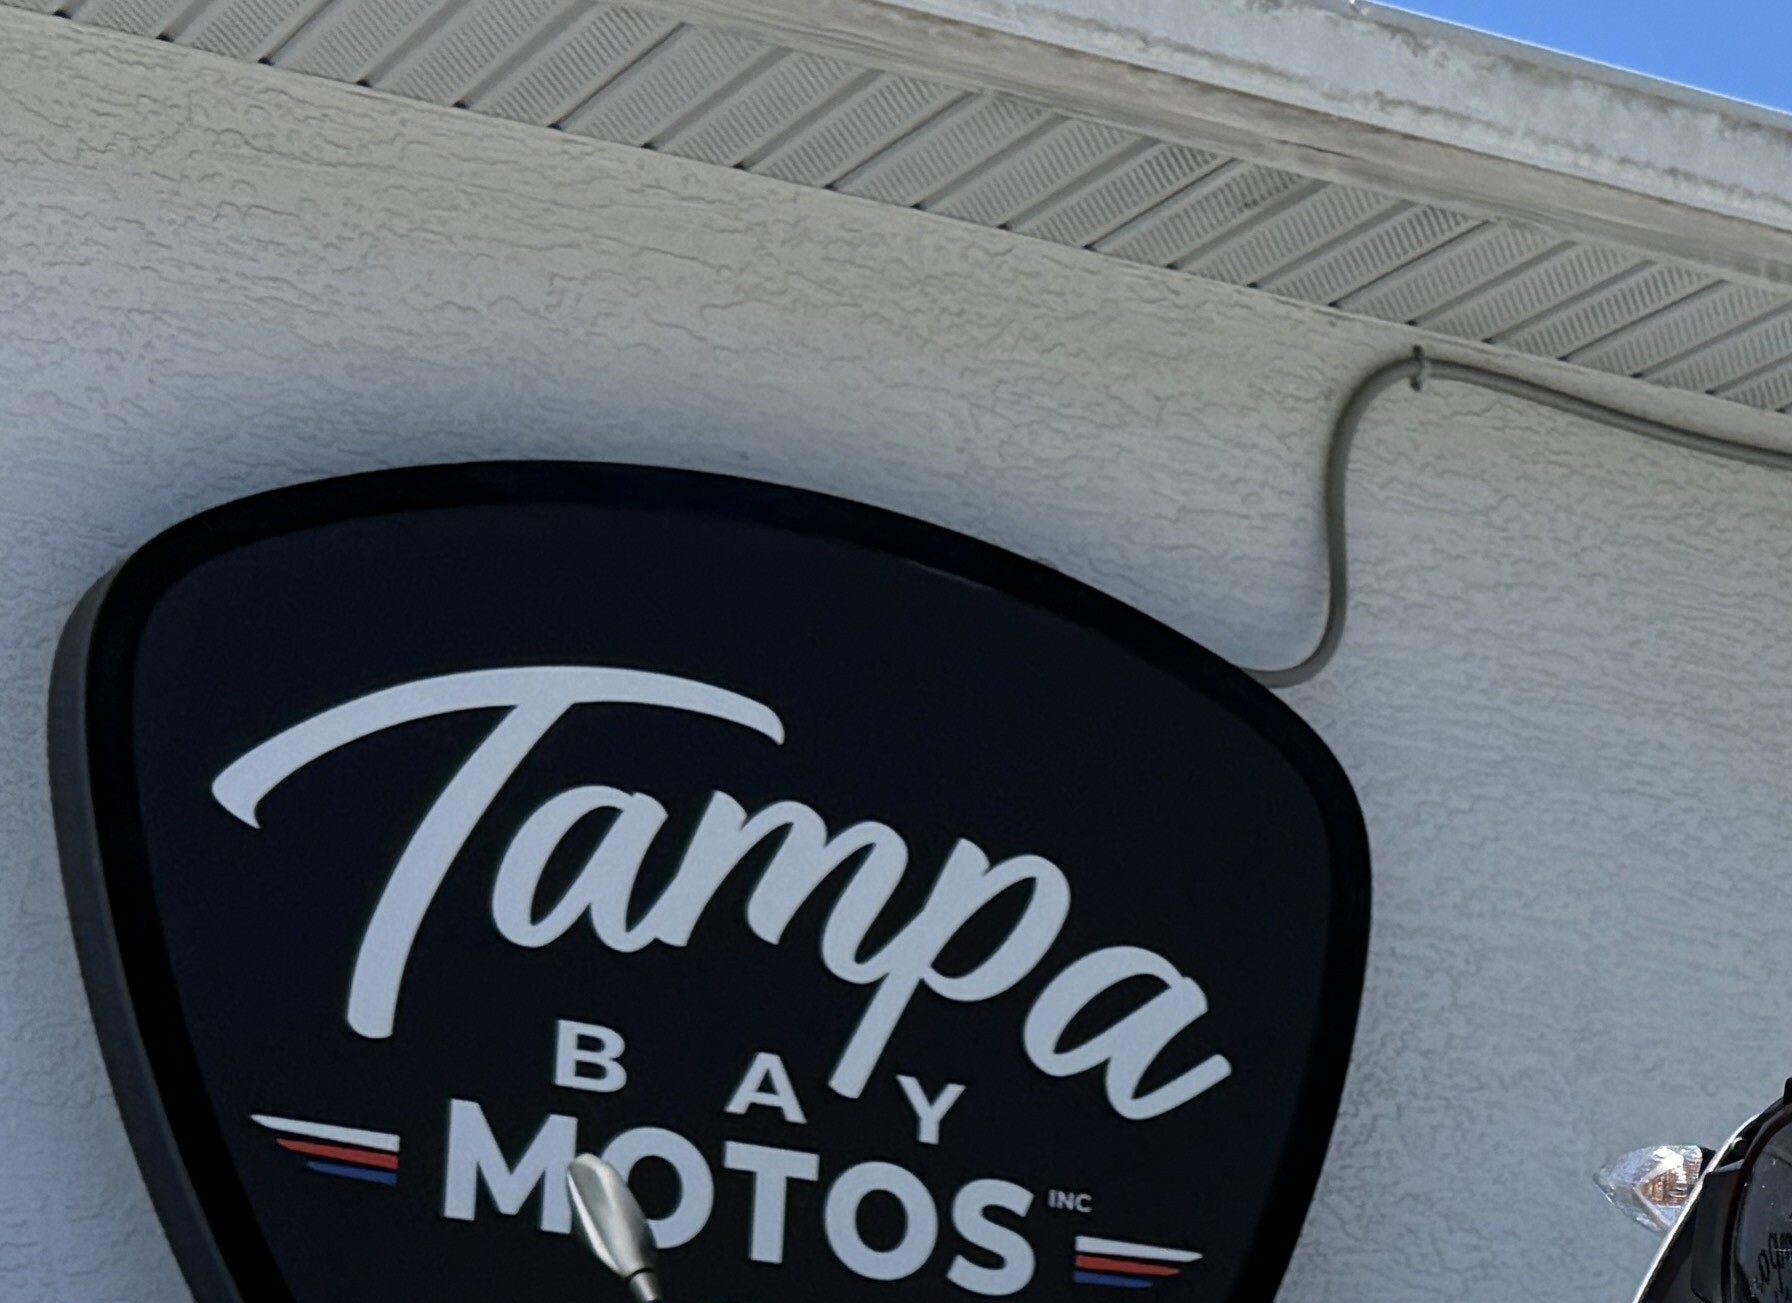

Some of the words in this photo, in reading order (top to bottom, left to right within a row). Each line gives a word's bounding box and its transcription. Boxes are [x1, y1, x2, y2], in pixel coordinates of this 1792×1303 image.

[211, 665, 1233, 1122] Tampa
[551, 1018, 967, 1145] BAY
[440, 1097, 1038, 1297] MOTOS
[1048, 1189, 1093, 1213] INC
